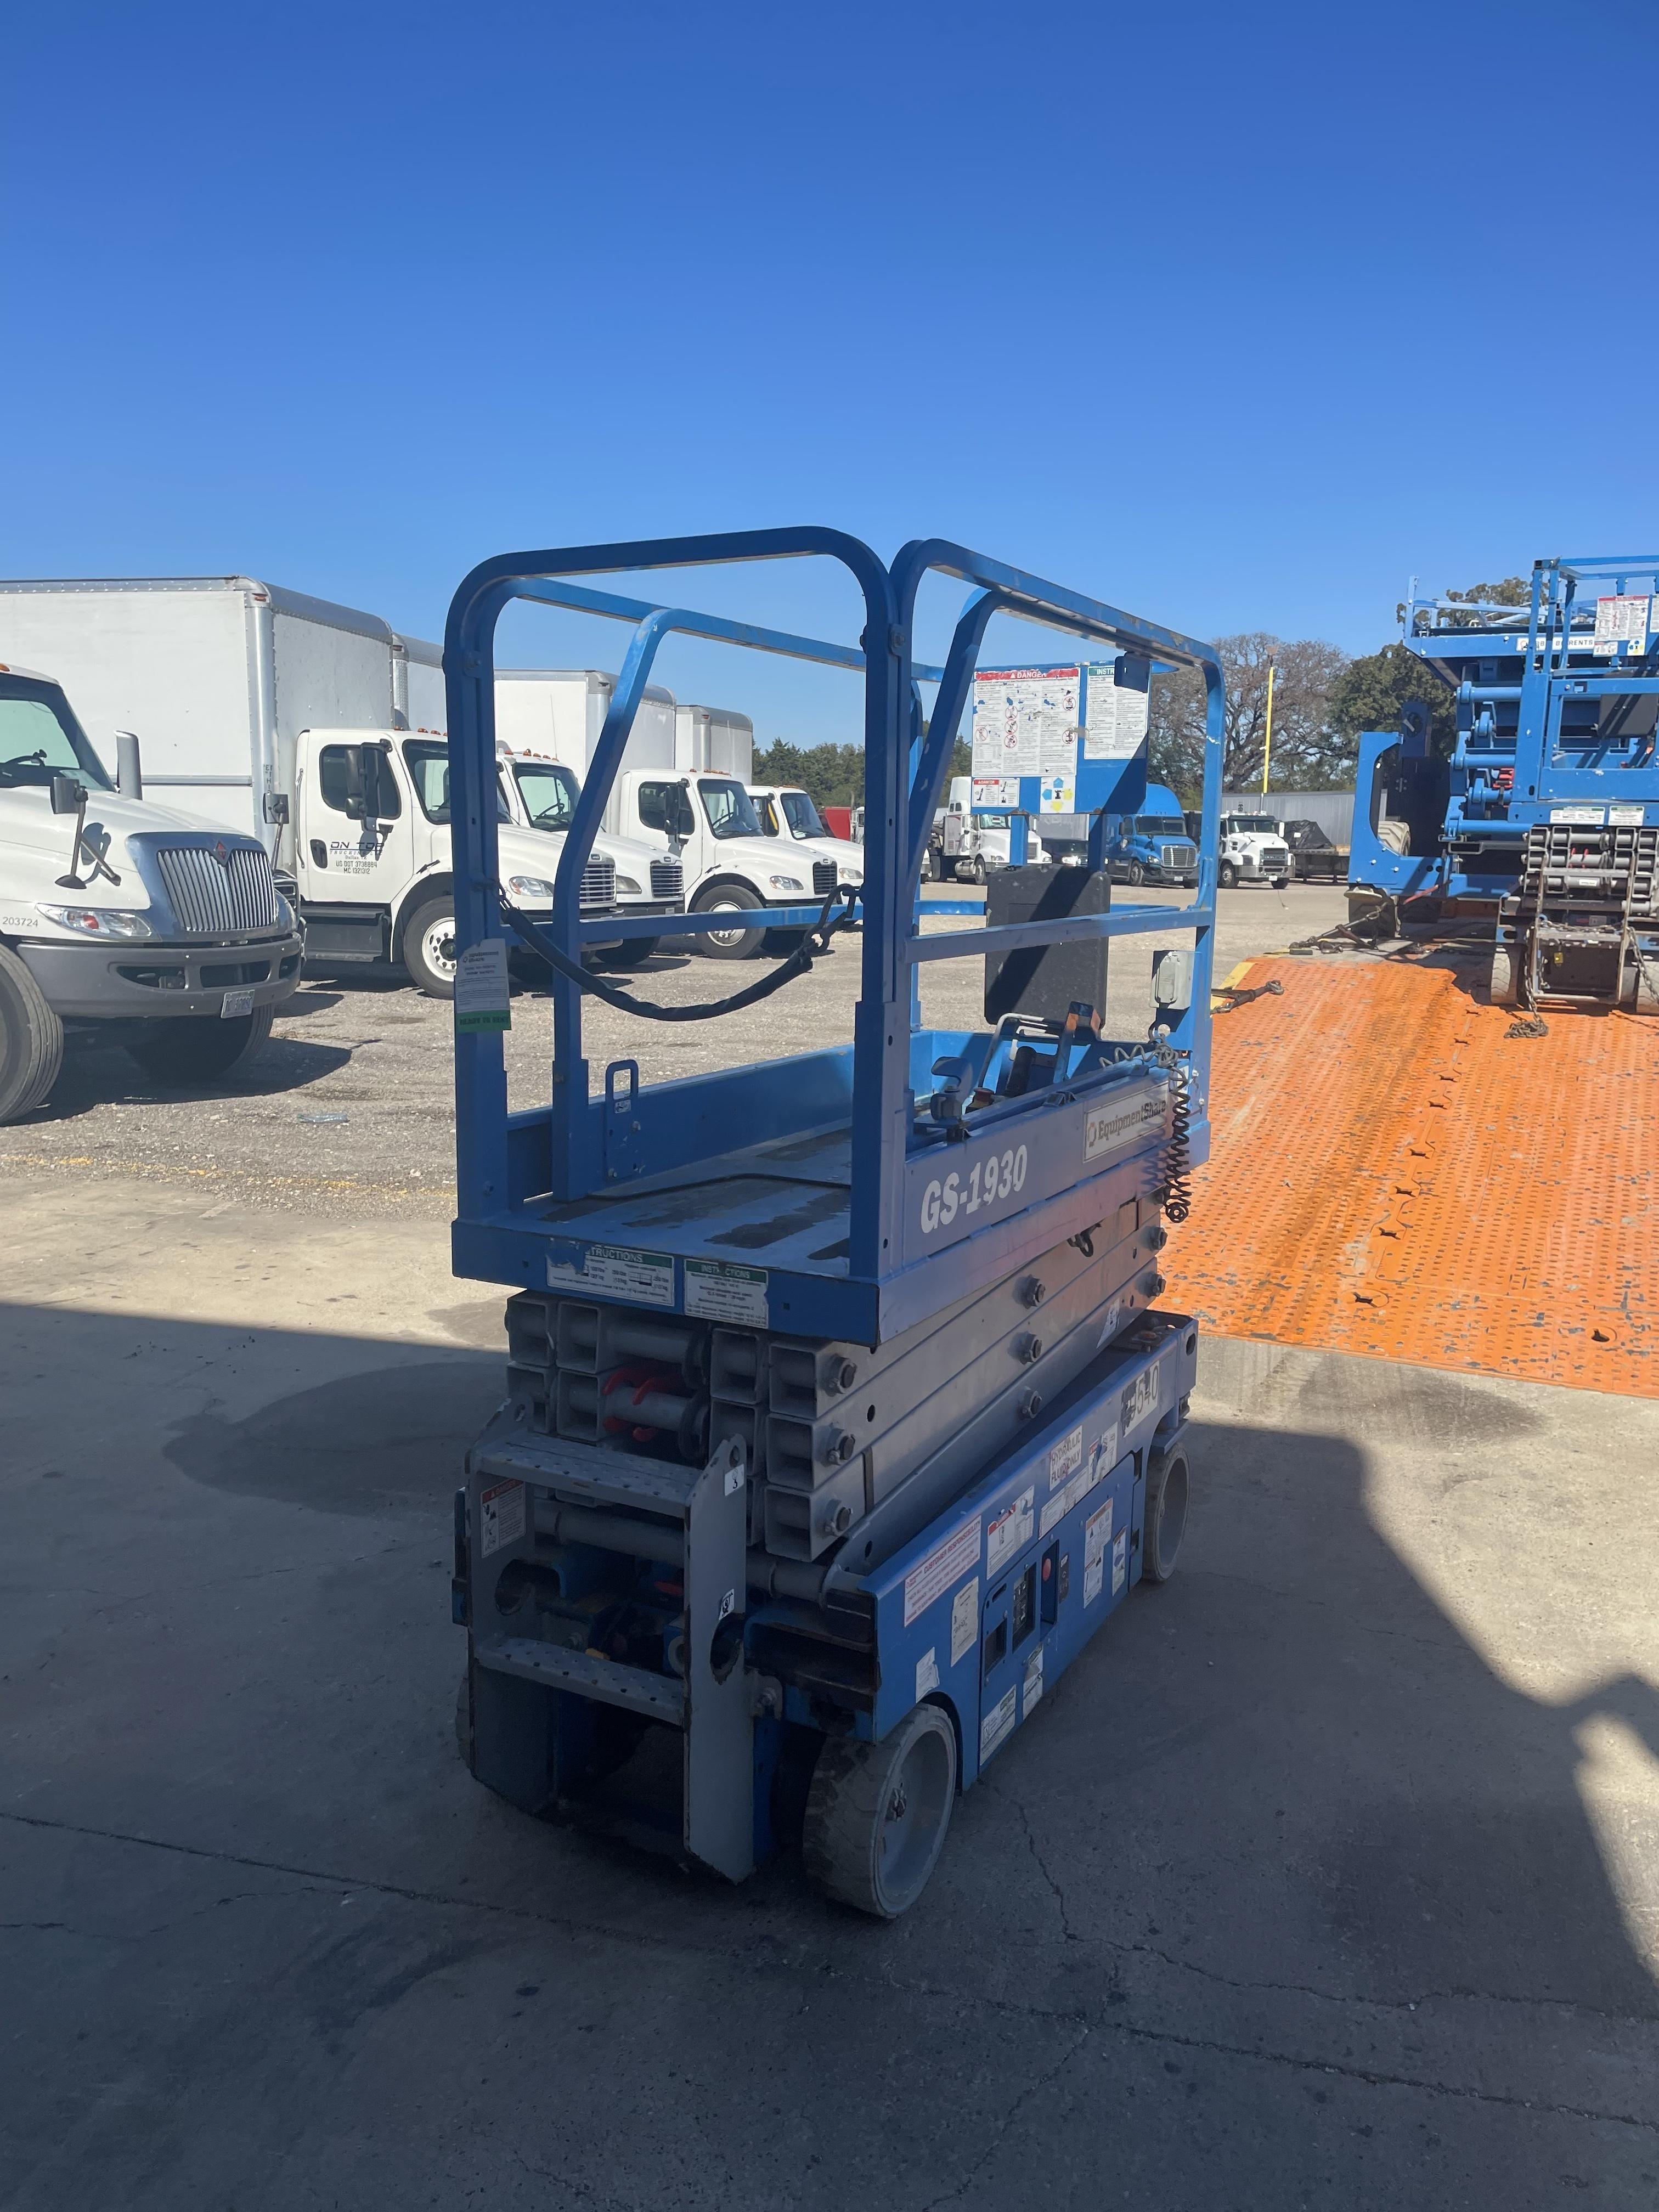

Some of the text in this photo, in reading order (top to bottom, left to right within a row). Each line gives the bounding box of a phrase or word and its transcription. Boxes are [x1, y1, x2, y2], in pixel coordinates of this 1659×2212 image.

[3, 917, 38, 927] 203724
[1098, 1099, 1166, 1140] EquipmentShare
[921, 1144, 1027, 1233] GS-1930
[1051, 1432, 1081, 1466] HYDRAULIC
